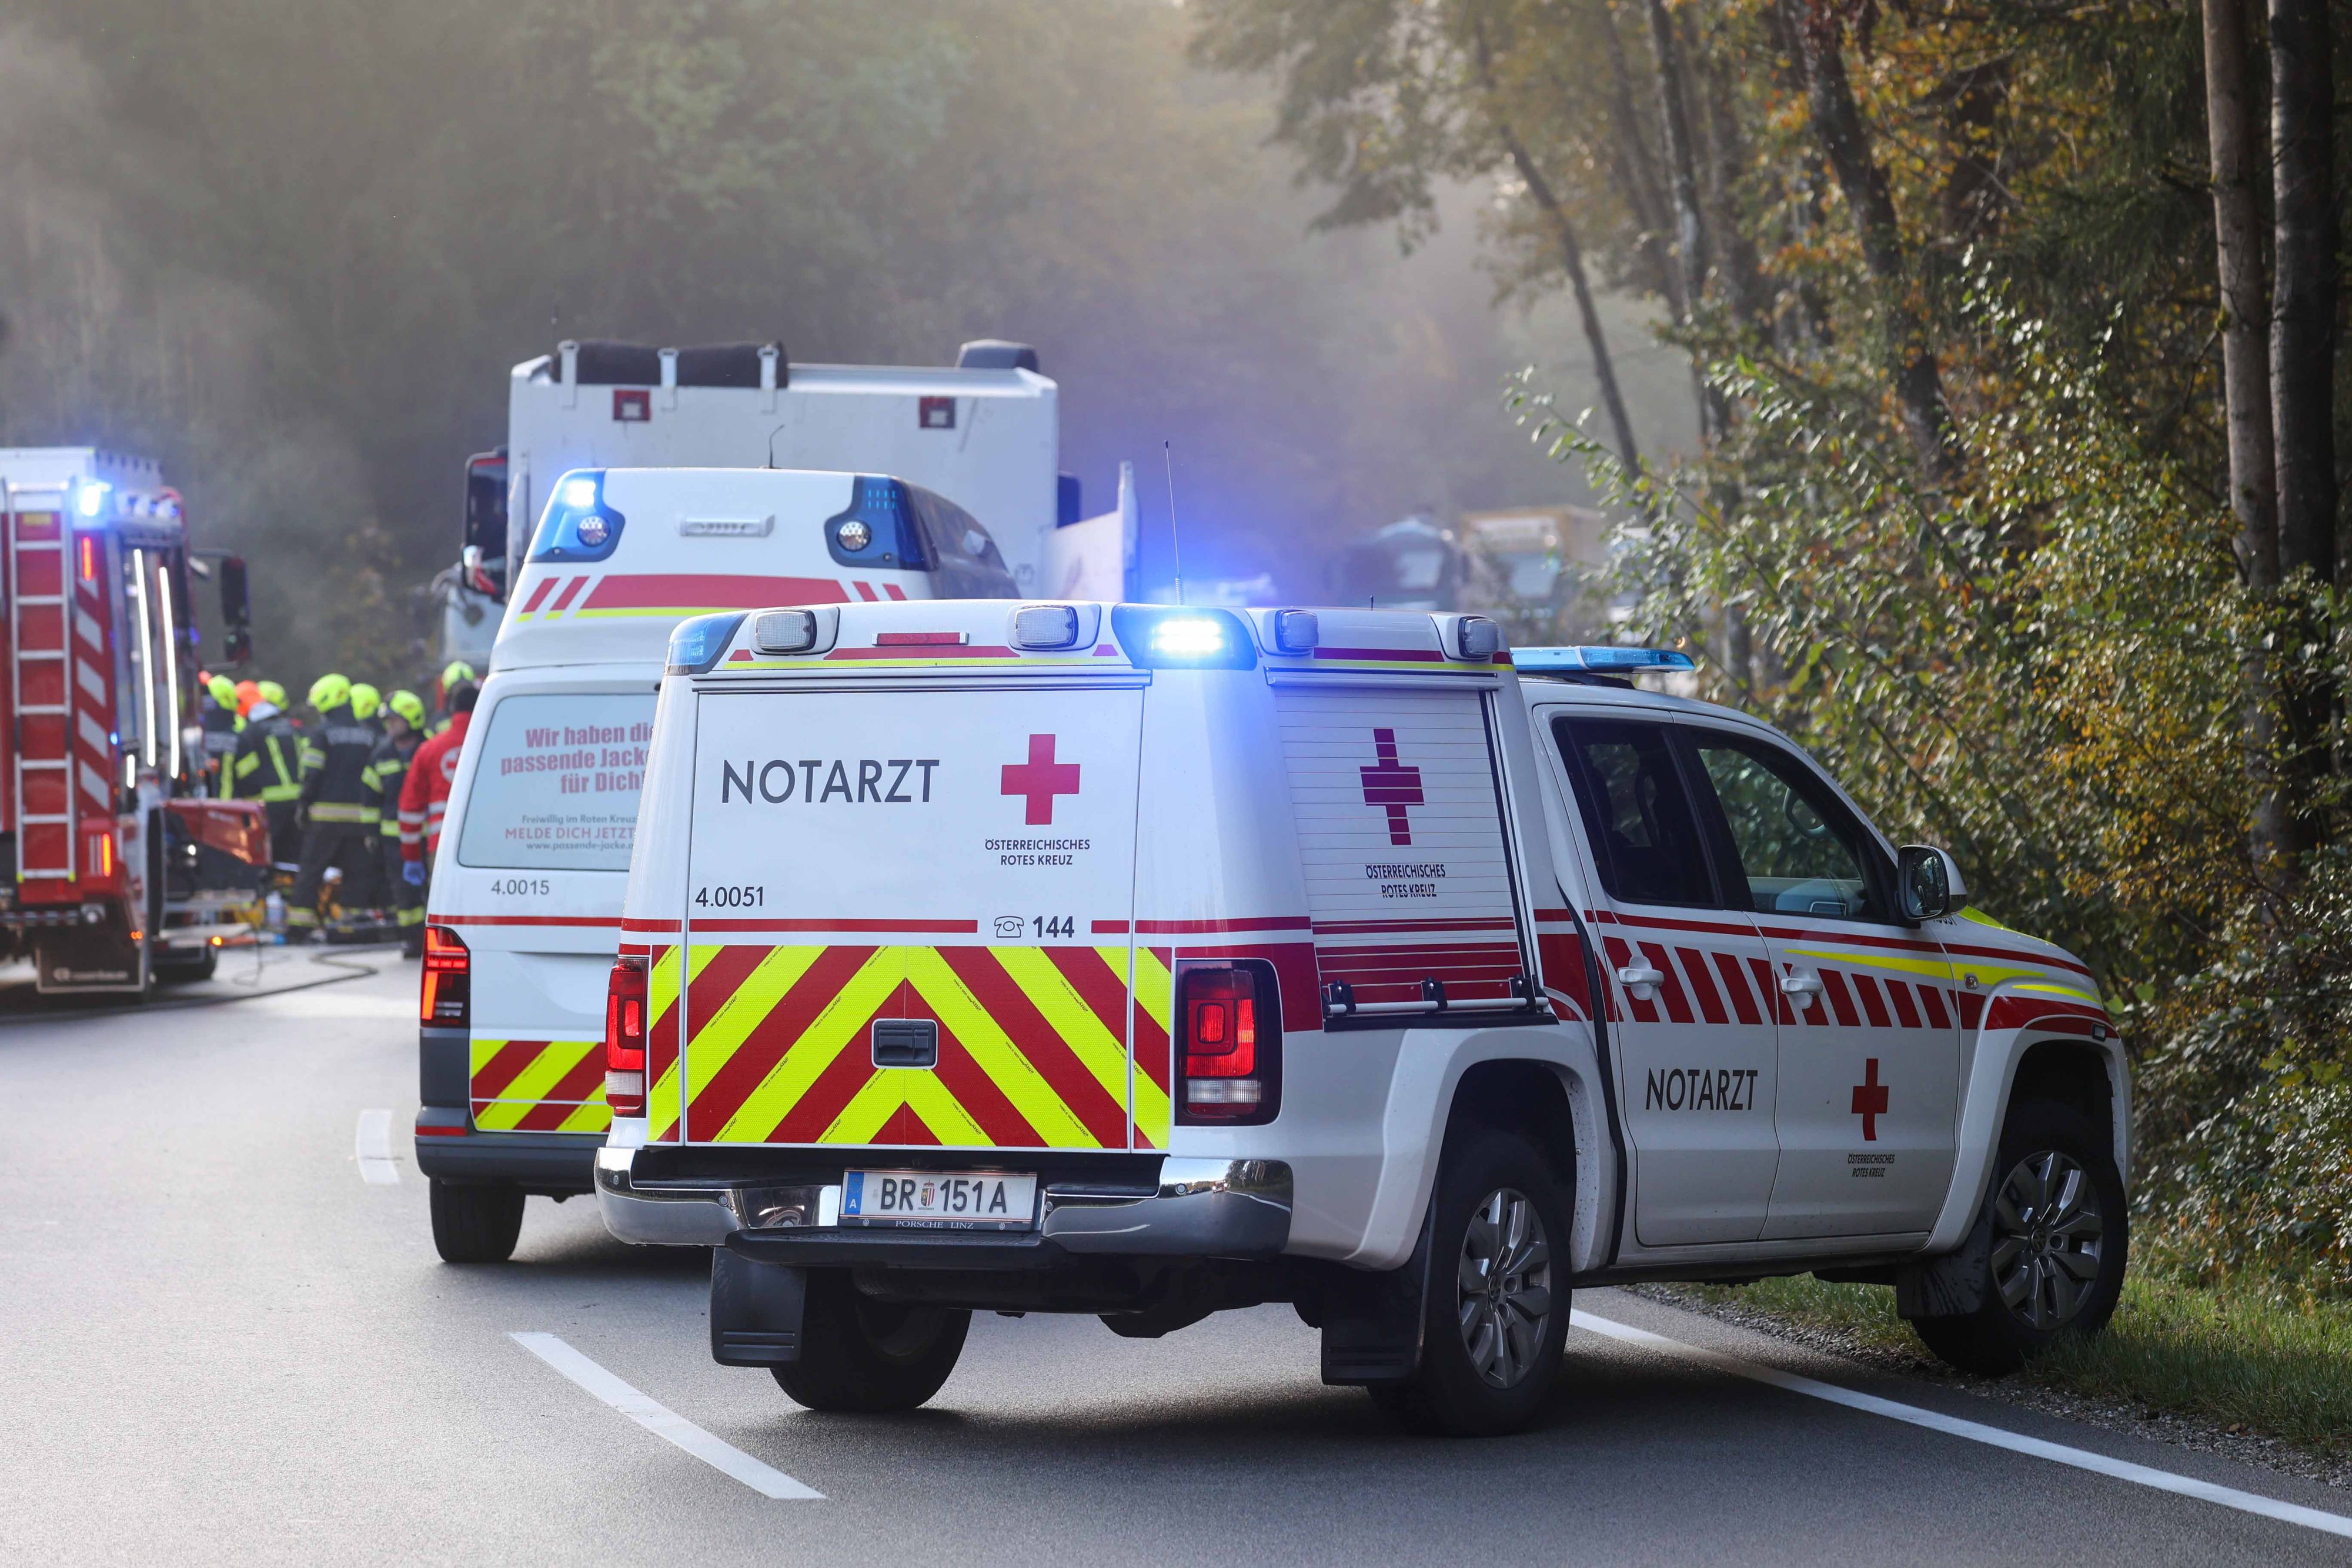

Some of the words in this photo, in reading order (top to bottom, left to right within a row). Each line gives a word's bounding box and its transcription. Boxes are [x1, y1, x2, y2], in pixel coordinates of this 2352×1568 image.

[526, 728, 560, 748] Wir
[564, 725, 625, 746] haben
[630, 723, 653, 743] di
[501, 750, 595, 775] passende
[600, 746, 650, 768] Jack
[560, 773, 590, 794] für
[721, 759, 940, 804] NOTARZT
[522, 814, 564, 824] Freiwillig
[566, 814, 577, 823] im
[580, 815, 607, 823] Roten
[505, 827, 551, 840] MELDE
[556, 827, 591, 839] DICH
[594, 827, 635, 839] JETZT
[985, 838, 1090, 850] ÖSTERREICHISCHES
[1000, 855, 1035, 865] ROTES
[1038, 855, 1073, 865] KREUZ
[1365, 864, 1446, 878] ÖSTERREICHISCHES
[491, 880, 549, 895] 4.0015
[1381, 884, 1408, 898] ROTES
[1409, 884, 1437, 897] KREUZ
[695, 886, 764, 907] 4.0051
[1033, 916, 1075, 938] 144
[1646, 1068, 1758, 1111] NOTARZT
[1847, 1154, 1895, 1164] ÖSTERREICHISCHES
[1852, 1168, 1869, 1178] ROTES
[1869, 1168, 1886, 1177] KREUZ
[881, 1178, 916, 1211] BR
[940, 1179, 1007, 1213] 151A
[849, 1198, 857, 1209] A
